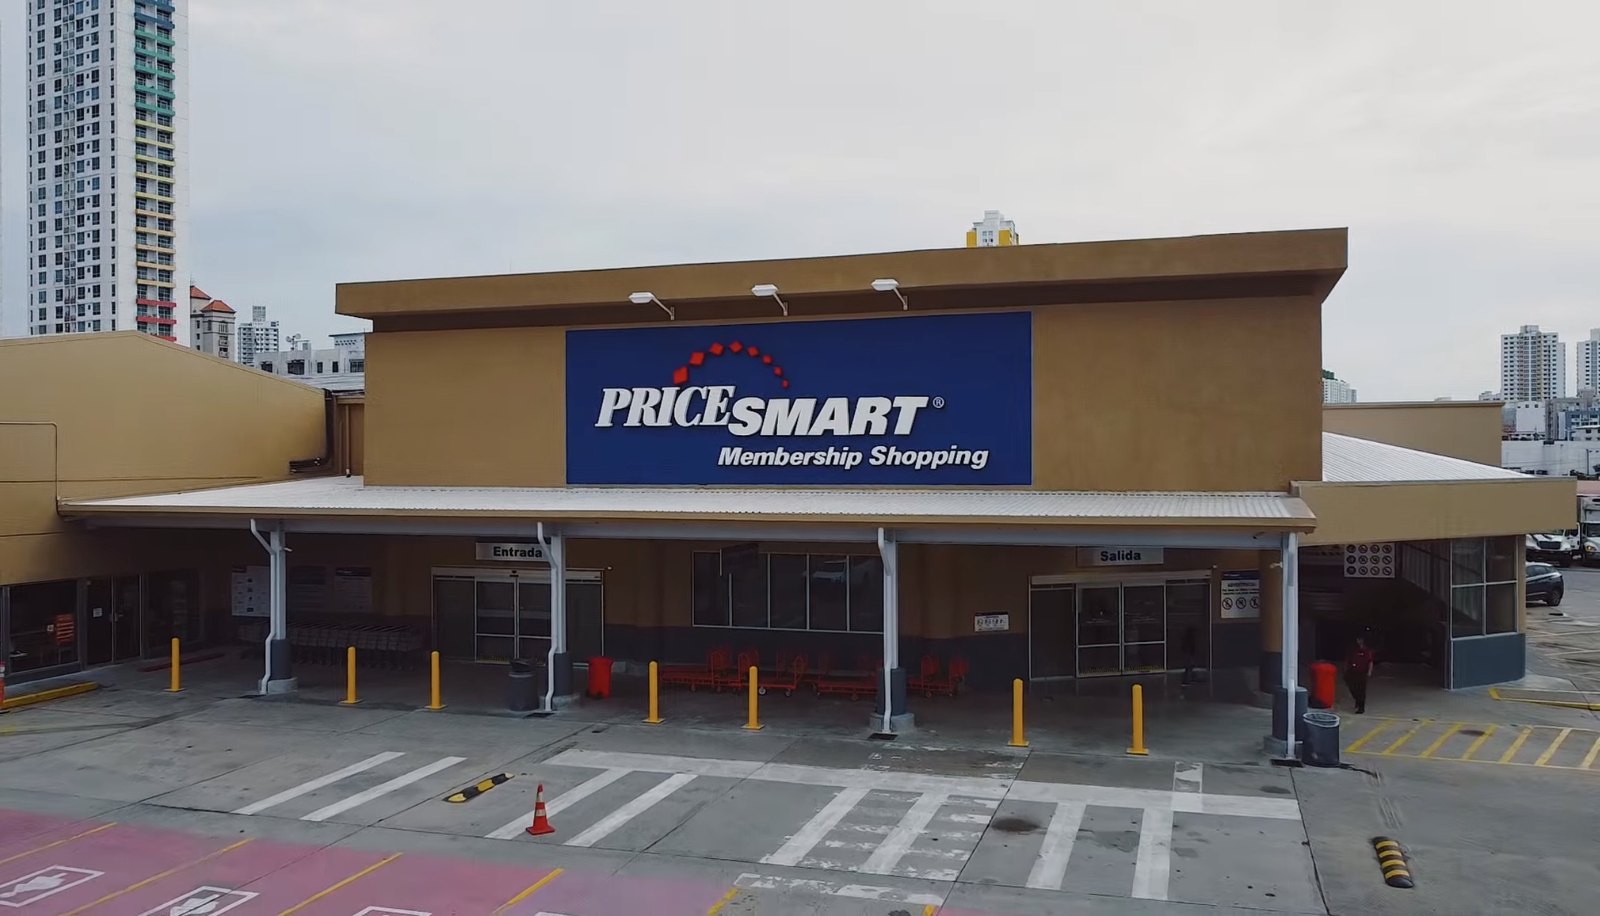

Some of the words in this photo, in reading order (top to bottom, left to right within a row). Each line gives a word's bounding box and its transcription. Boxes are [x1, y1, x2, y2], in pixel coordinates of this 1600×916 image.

[594, 386, 929, 437] PRICESMART
[718, 446, 863, 470] Membership
[869, 444, 989, 471] Shopping
[493, 546, 543, 558] Entrada
[1100, 550, 1141, 561] Salida
